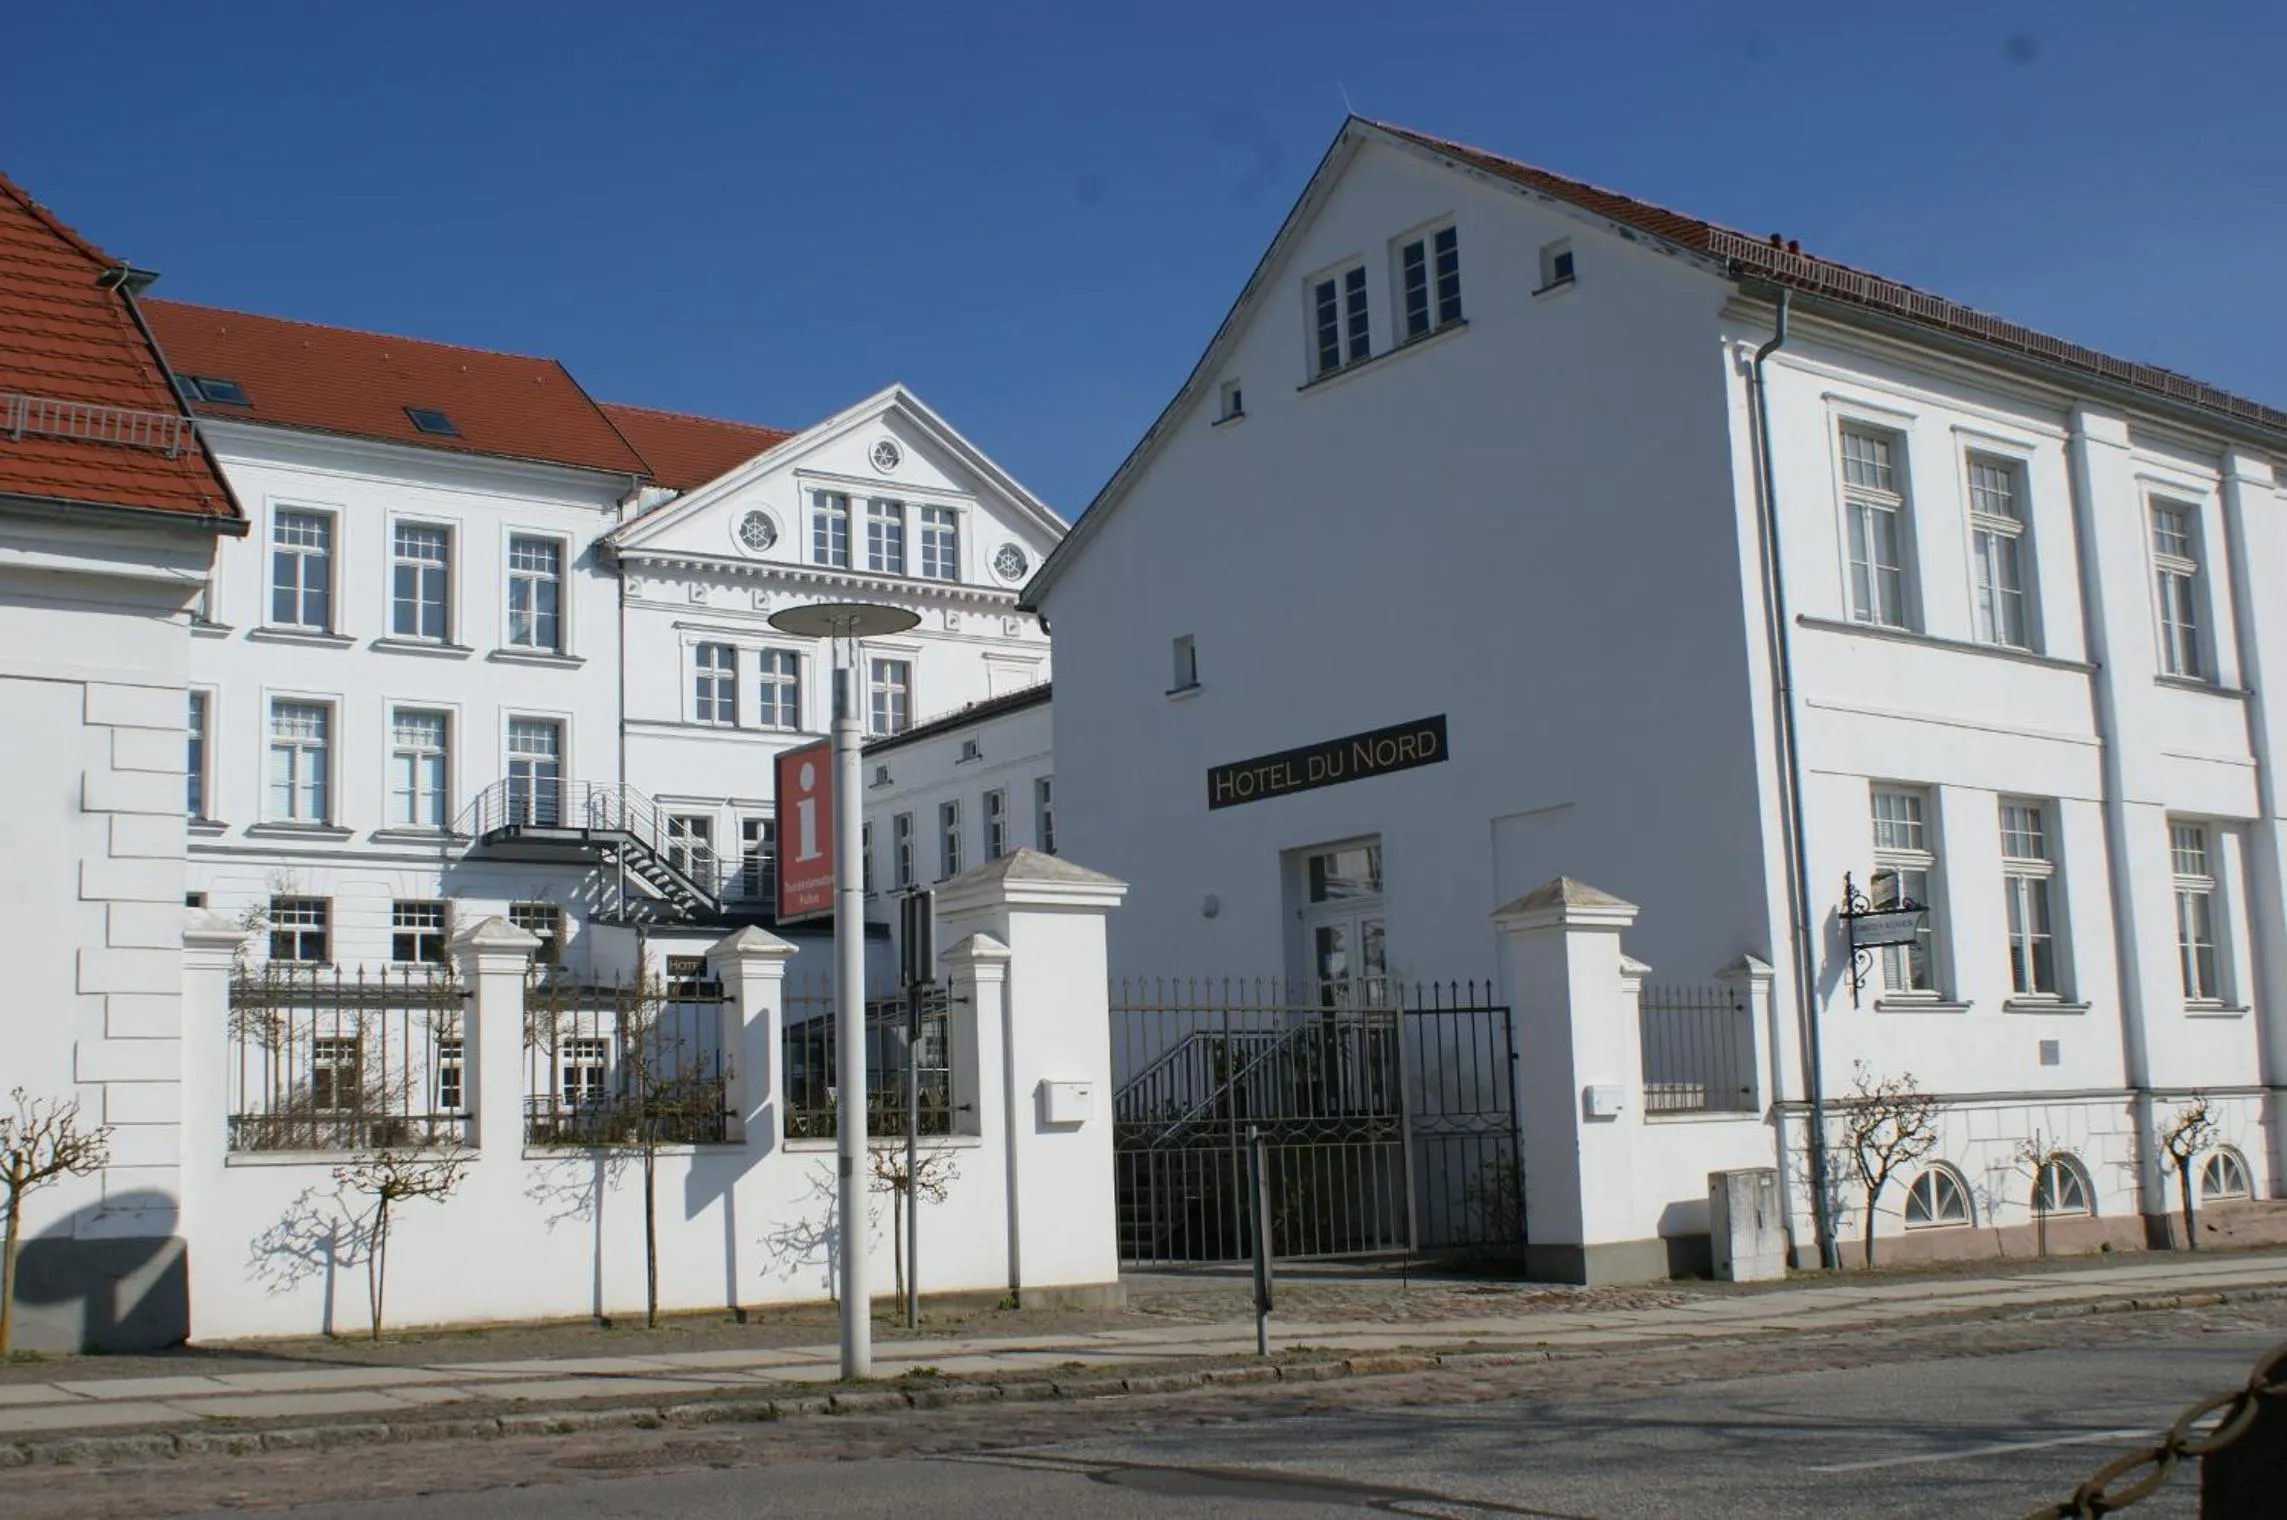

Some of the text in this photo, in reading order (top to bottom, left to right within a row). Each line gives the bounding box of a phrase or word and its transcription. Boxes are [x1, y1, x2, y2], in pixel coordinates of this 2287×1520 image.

[1214, 730, 1438, 801] HOTEL DU NORD
[795, 761, 823, 863] i
